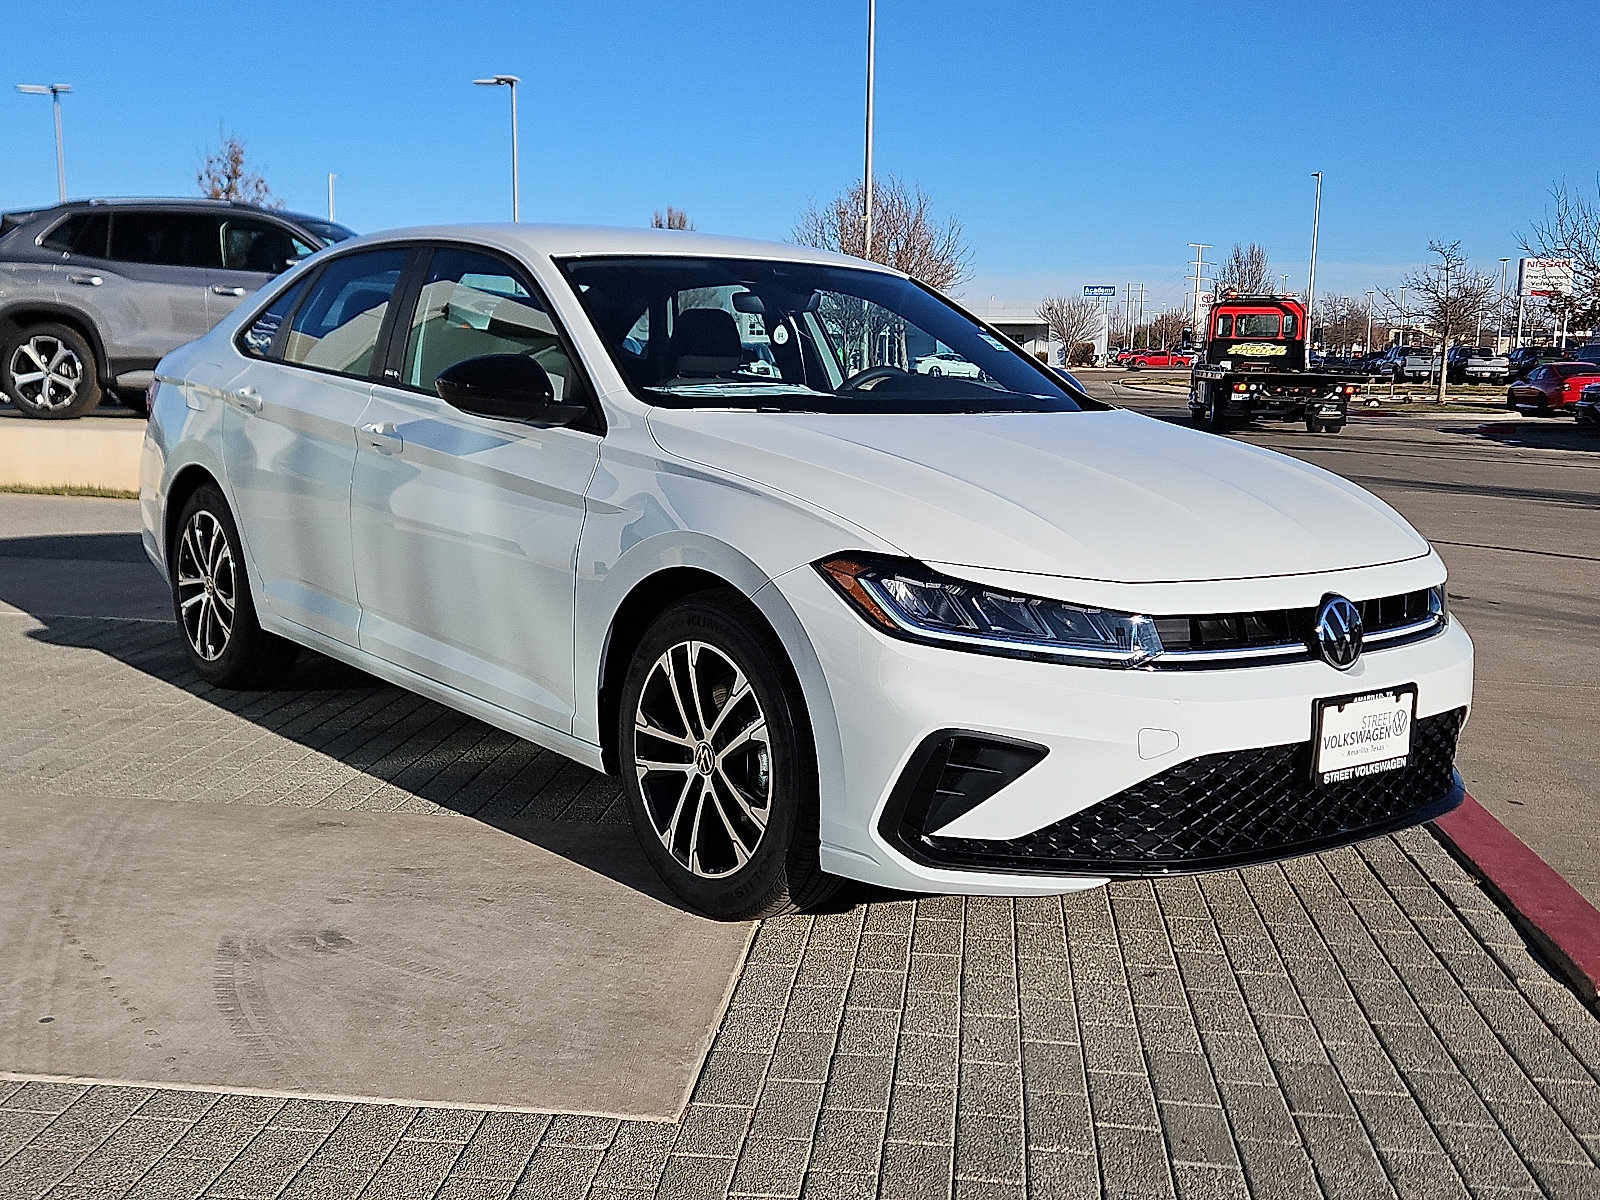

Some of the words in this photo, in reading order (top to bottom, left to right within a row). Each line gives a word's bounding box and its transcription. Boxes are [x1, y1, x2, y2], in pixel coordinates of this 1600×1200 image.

[1526, 260, 1571, 268] NISSAN
[1085, 286, 1115, 295] Academy
[1361, 711, 1392, 730] STREET
[1323, 725, 1392, 751] VOLKSWAGEN
[1323, 767, 1354, 785] STREET
[1354, 757, 1407, 777] VOLKSWAGEN
